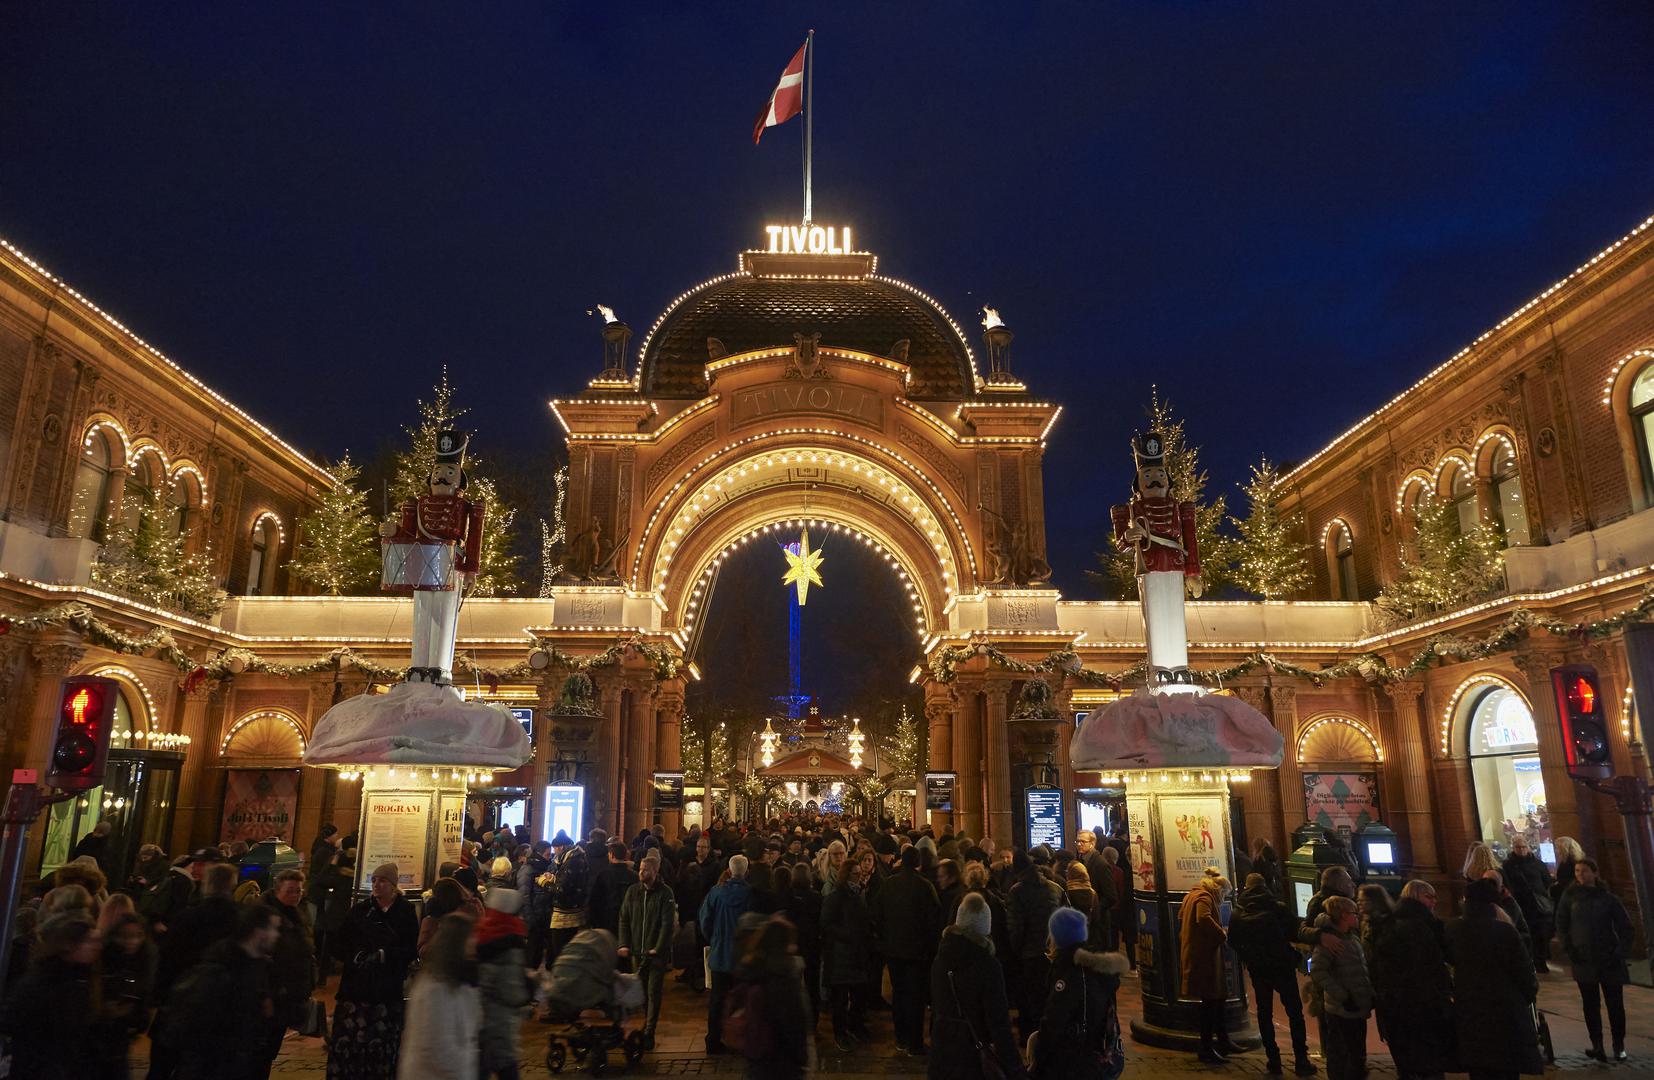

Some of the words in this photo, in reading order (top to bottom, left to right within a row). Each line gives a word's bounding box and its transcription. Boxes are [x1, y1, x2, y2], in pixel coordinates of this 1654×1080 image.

[765, 225, 852, 255] TIVOLI
[743, 386, 867, 416] TIVOLI
[255, 812, 289, 824] Tivoli
[373, 805, 421, 813] PROGRAM
